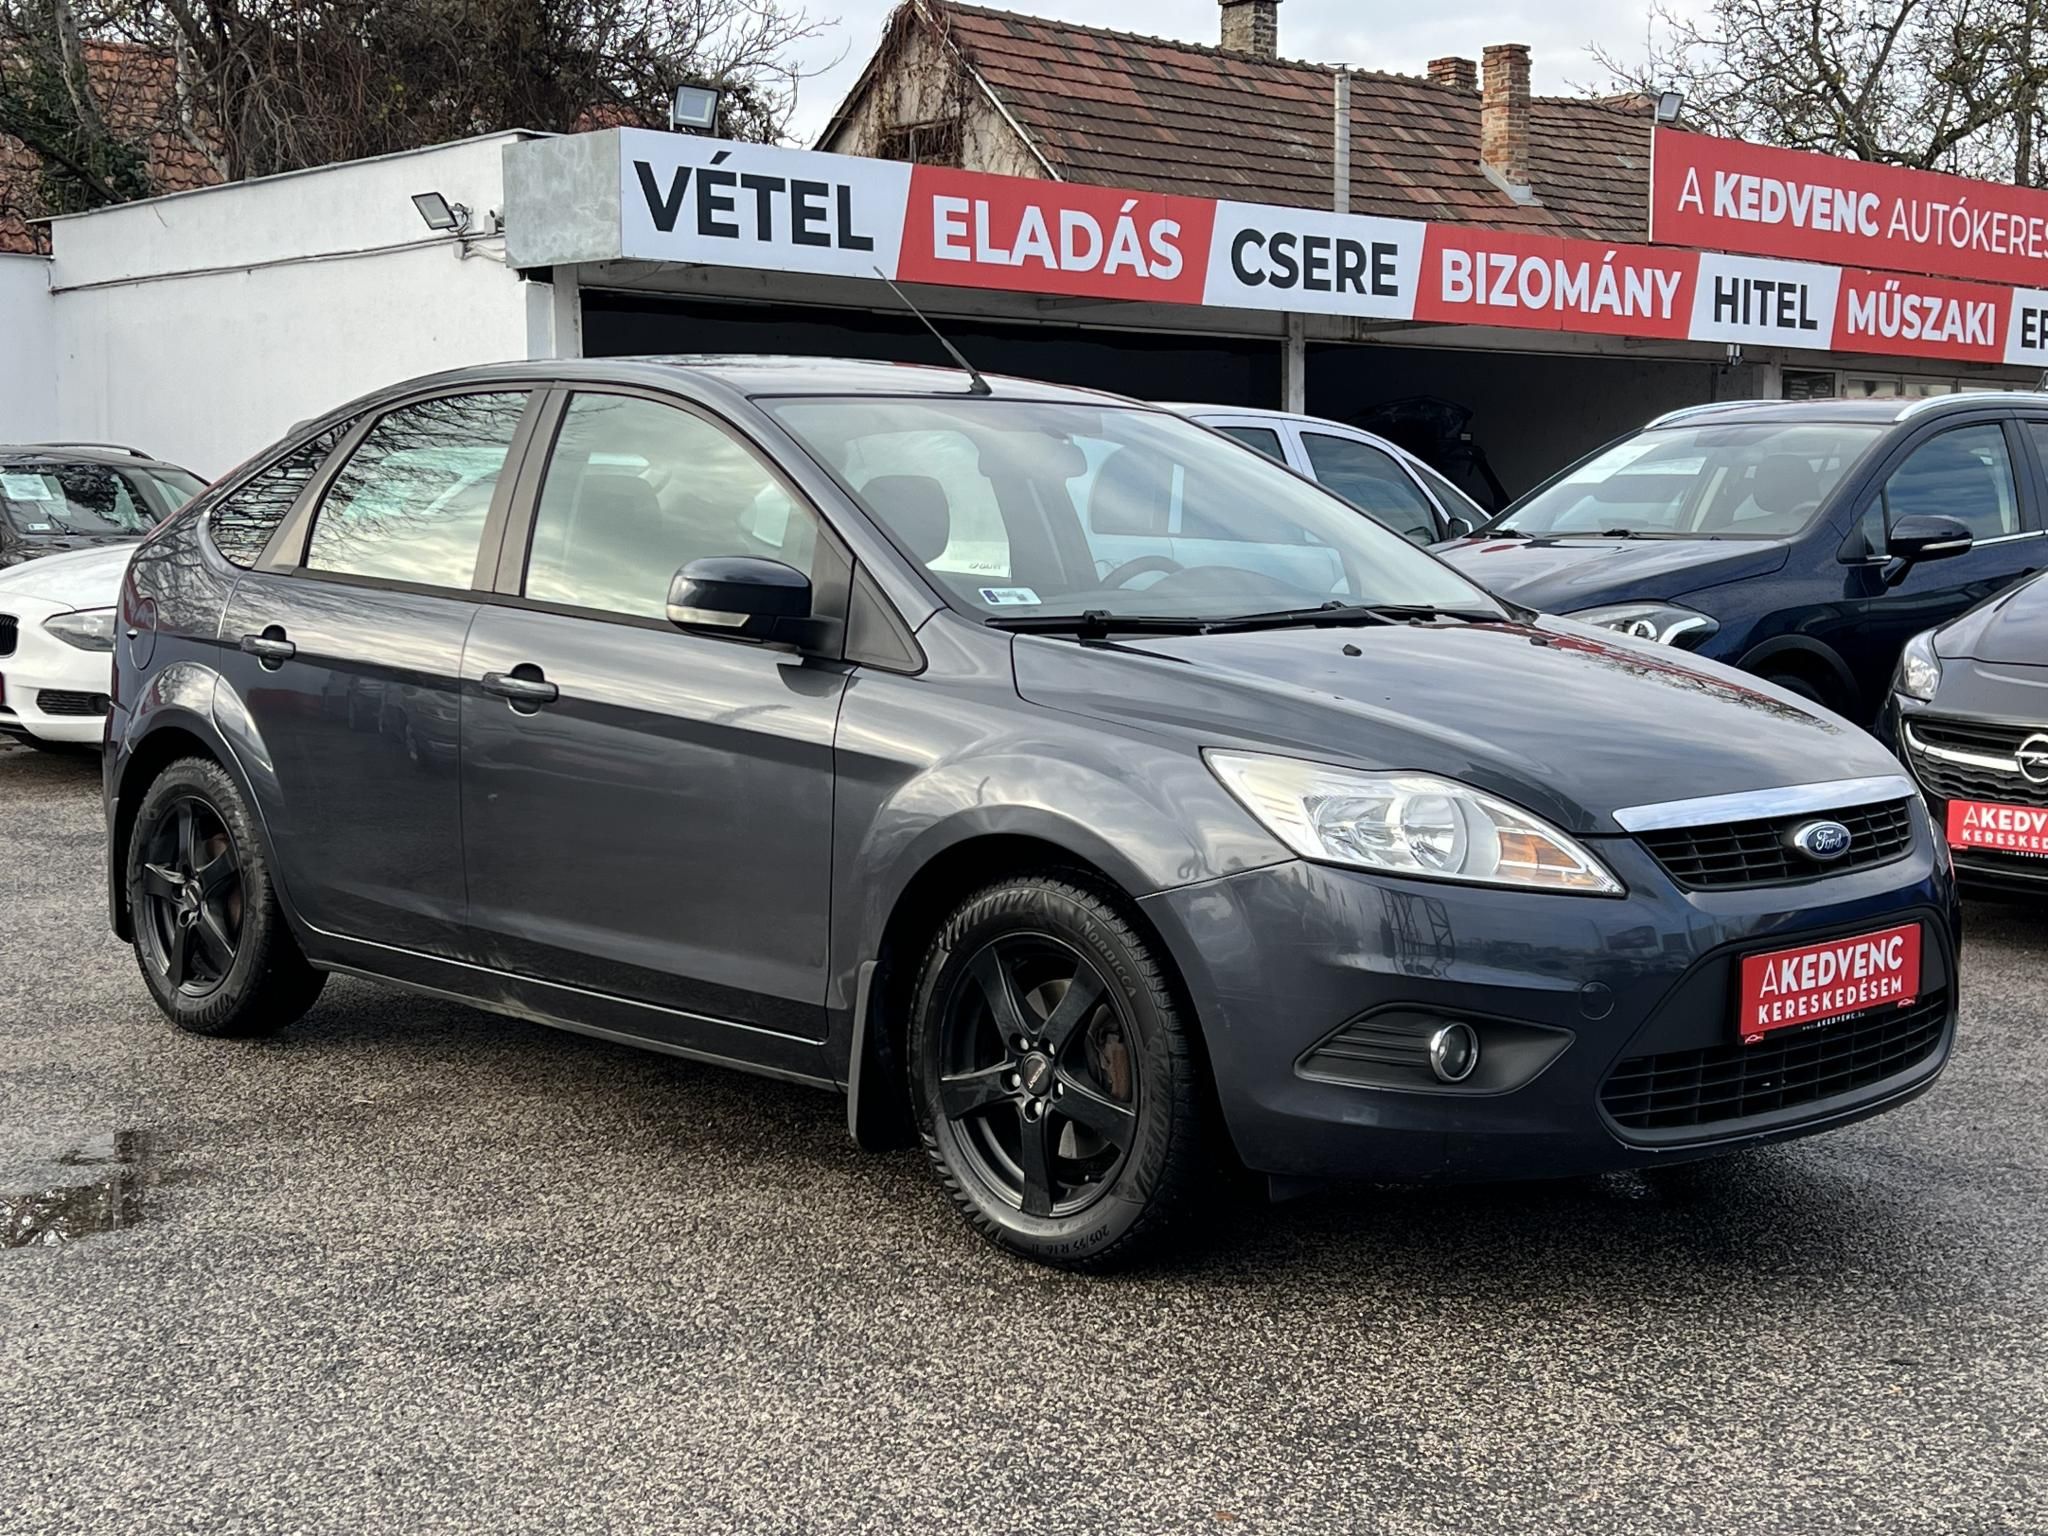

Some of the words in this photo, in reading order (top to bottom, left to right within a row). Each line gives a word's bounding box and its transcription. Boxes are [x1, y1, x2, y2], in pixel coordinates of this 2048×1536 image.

[1677, 167, 1704, 215] A
[1713, 170, 1880, 238] KEDVENC
[1887, 196, 2048, 260] AUTÓKERE
[634, 151, 874, 252] VÉTEL
[932, 195, 1182, 281] ELADÁS
[1231, 228, 1399, 297] CSERE
[1441, 248, 1682, 320] BIZOMÁNY
[1714, 275, 1818, 331] HITEL
[1847, 280, 1995, 346] MŰSZAKI
[1816, 829, 1842, 850] Ford
[1758, 975, 1902, 1025] KERESKEDÉSEM
[1073, 1224, 1110, 1251] 205/55
